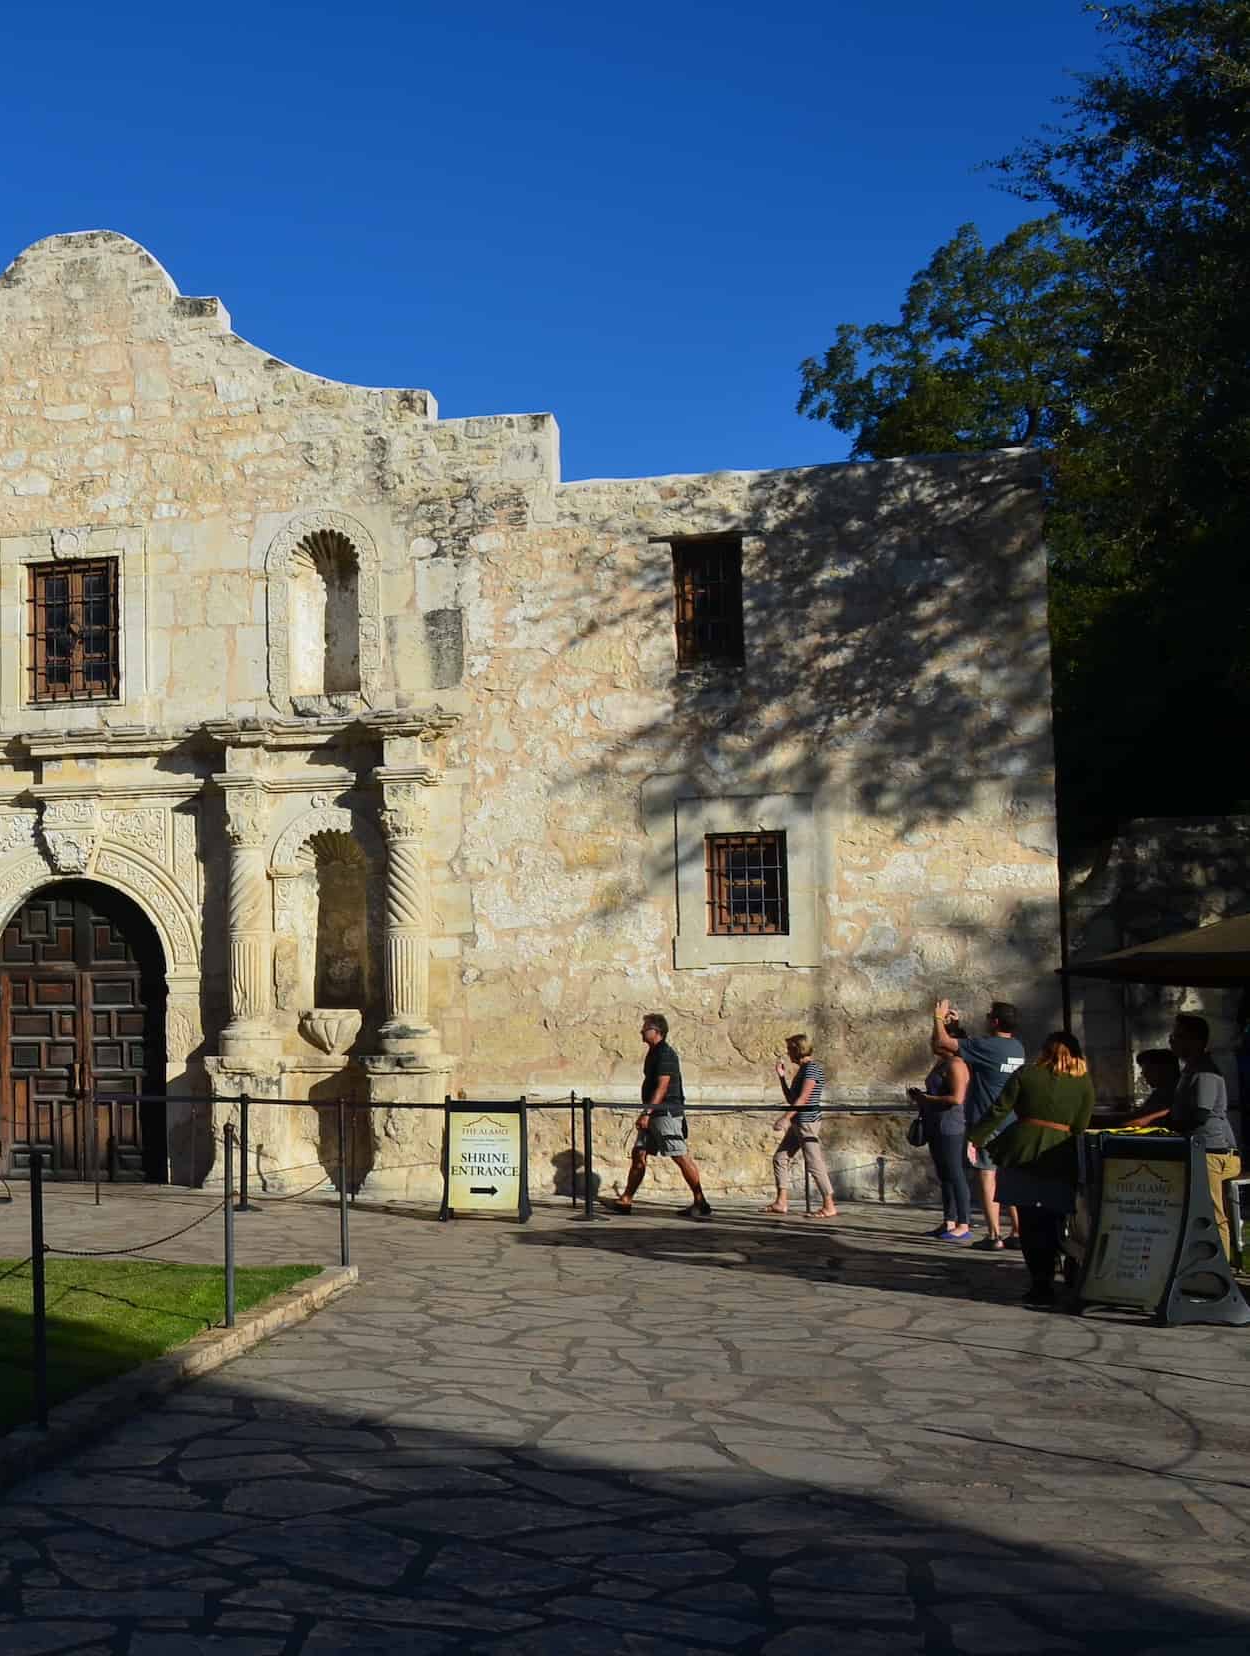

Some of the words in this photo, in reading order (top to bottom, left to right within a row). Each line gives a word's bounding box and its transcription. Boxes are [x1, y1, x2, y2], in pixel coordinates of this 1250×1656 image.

[462, 1127, 476, 1136] THE
[479, 1127, 509, 1136] ALAMO
[461, 1152, 510, 1163] SHRINE
[451, 1166, 520, 1177] ENTRANCE
